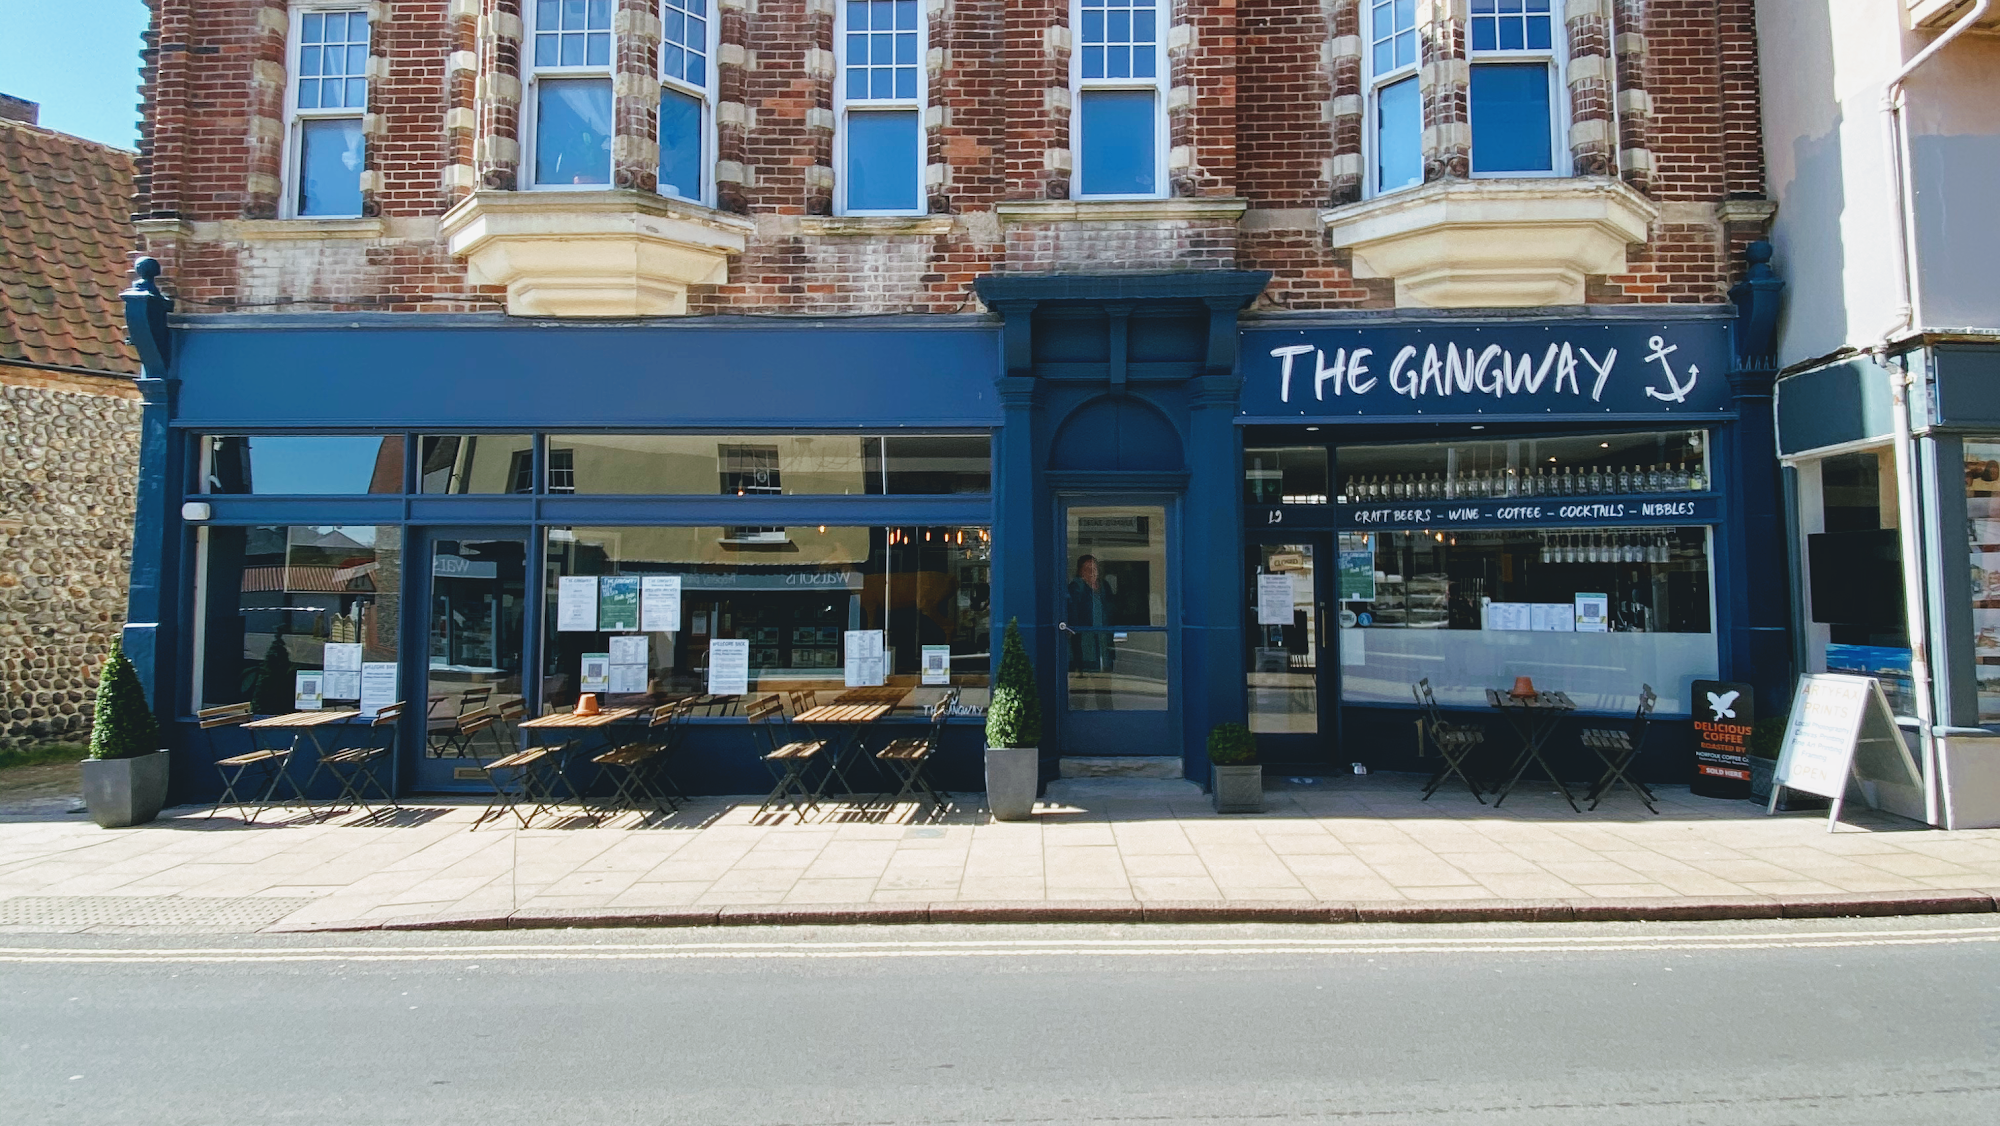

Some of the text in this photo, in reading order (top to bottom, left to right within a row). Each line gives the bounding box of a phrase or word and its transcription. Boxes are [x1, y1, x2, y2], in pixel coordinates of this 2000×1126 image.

[1270, 341, 1617, 402] THE GANGWAY
[1354, 509, 1392, 524] CRAFT
[1393, 508, 1432, 523] BEERS
[1449, 507, 1480, 520] WINE
[1497, 506, 1541, 520] COFFEE
[1559, 503, 1624, 518] COCKTAILS
[1641, 501, 1695, 516] NIBBLES
[1802, 684, 1858, 700] ARTYFAX
[1803, 701, 1848, 718] PRINTS
[1694, 721, 1752, 736] DELICIOUS
[1703, 731, 1743, 744] COFFEE
[1819, 733, 1845, 745] Printing
[1700, 742, 1734, 752] ROASTED
[1818, 742, 1843, 755] Printing
[1695, 751, 1720, 759] NORFOLK
[1721, 754, 1741, 762] COFFEE
[1801, 750, 1828, 763] Framing
[1706, 767, 1742, 778] SOLD HERE
[1793, 764, 1828, 781] OPEN
